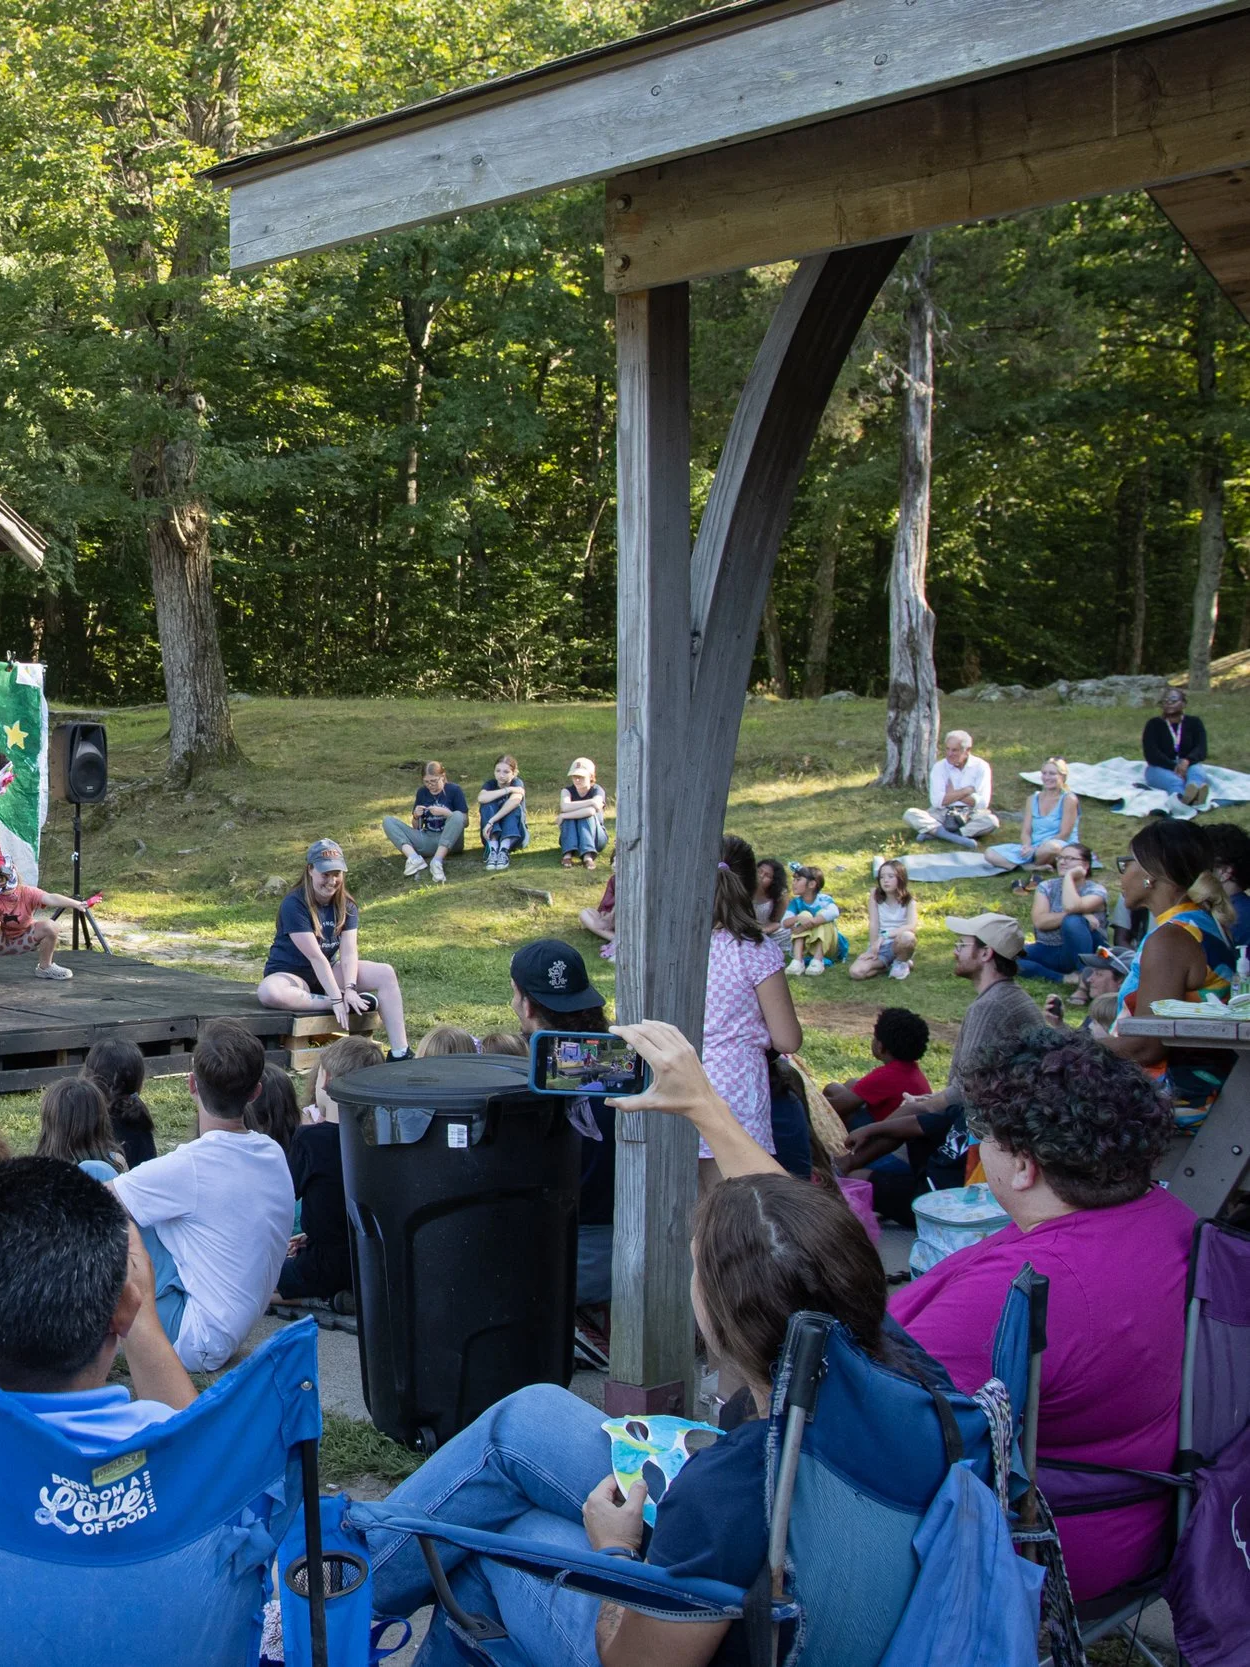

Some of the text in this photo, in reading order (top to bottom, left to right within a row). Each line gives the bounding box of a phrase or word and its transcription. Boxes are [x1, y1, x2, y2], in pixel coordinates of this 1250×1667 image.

[52, 1473, 90, 1492] BORN
[78, 1475, 141, 1503] FROM A
[35, 1486, 146, 1534] Love
[146, 1490, 157, 1512] SINCE
[82, 1507, 147, 1535] OF FOOD
